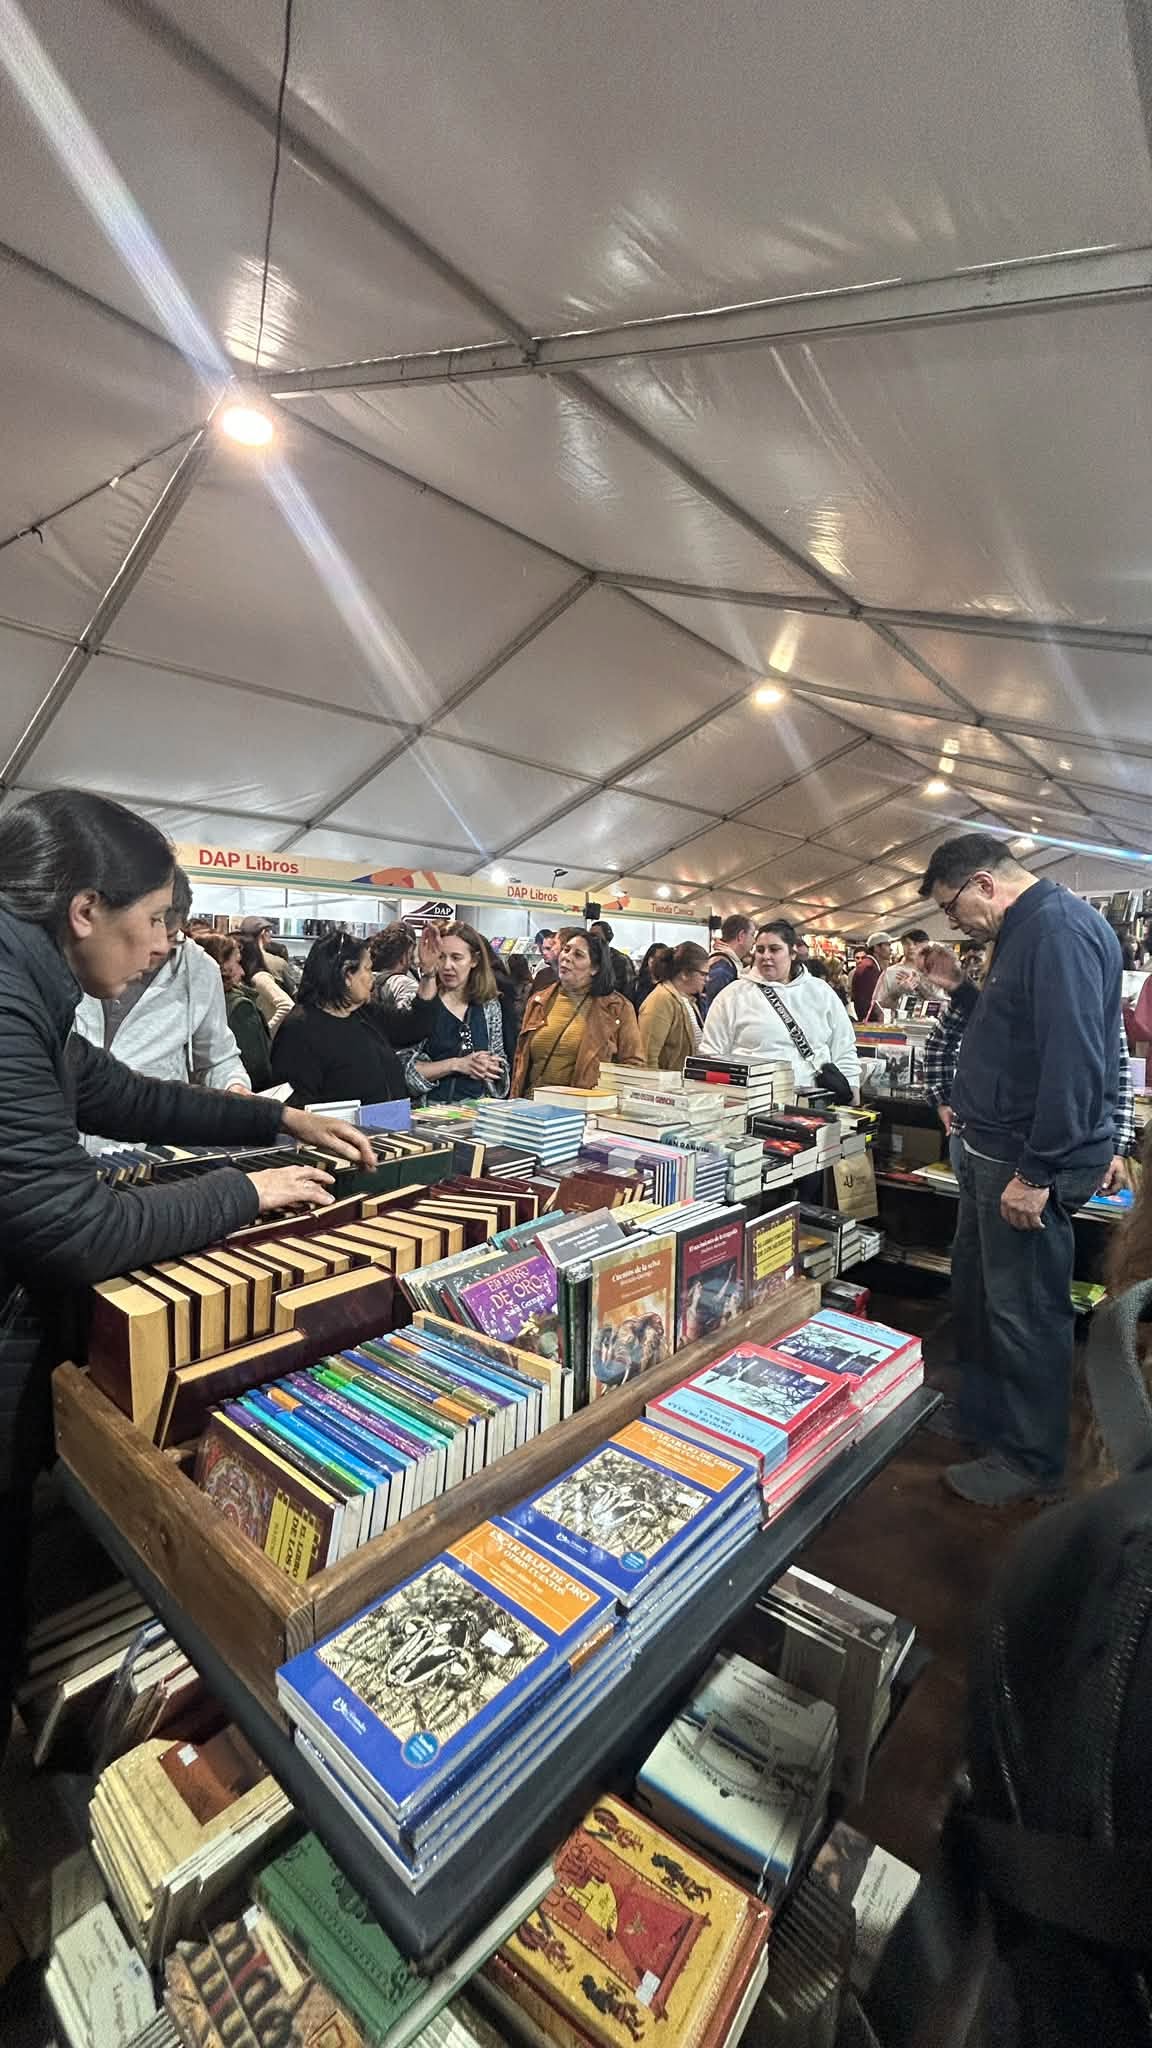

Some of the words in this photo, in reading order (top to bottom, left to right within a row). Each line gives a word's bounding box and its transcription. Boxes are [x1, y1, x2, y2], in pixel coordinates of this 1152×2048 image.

[199, 849, 241, 868] DAP
[245, 854, 299, 874] Libros
[507, 886, 528, 898] DAP
[529, 887, 559, 903] Libros
[434, 906, 452, 916] DAP
[490, 1289, 513, 1310] DE
[513, 1275, 543, 1298] ORO
[489, 1529, 551, 1574] ESCARABAJO
[550, 1571, 568, 1586] DE
[565, 1581, 591, 1602] ORO
